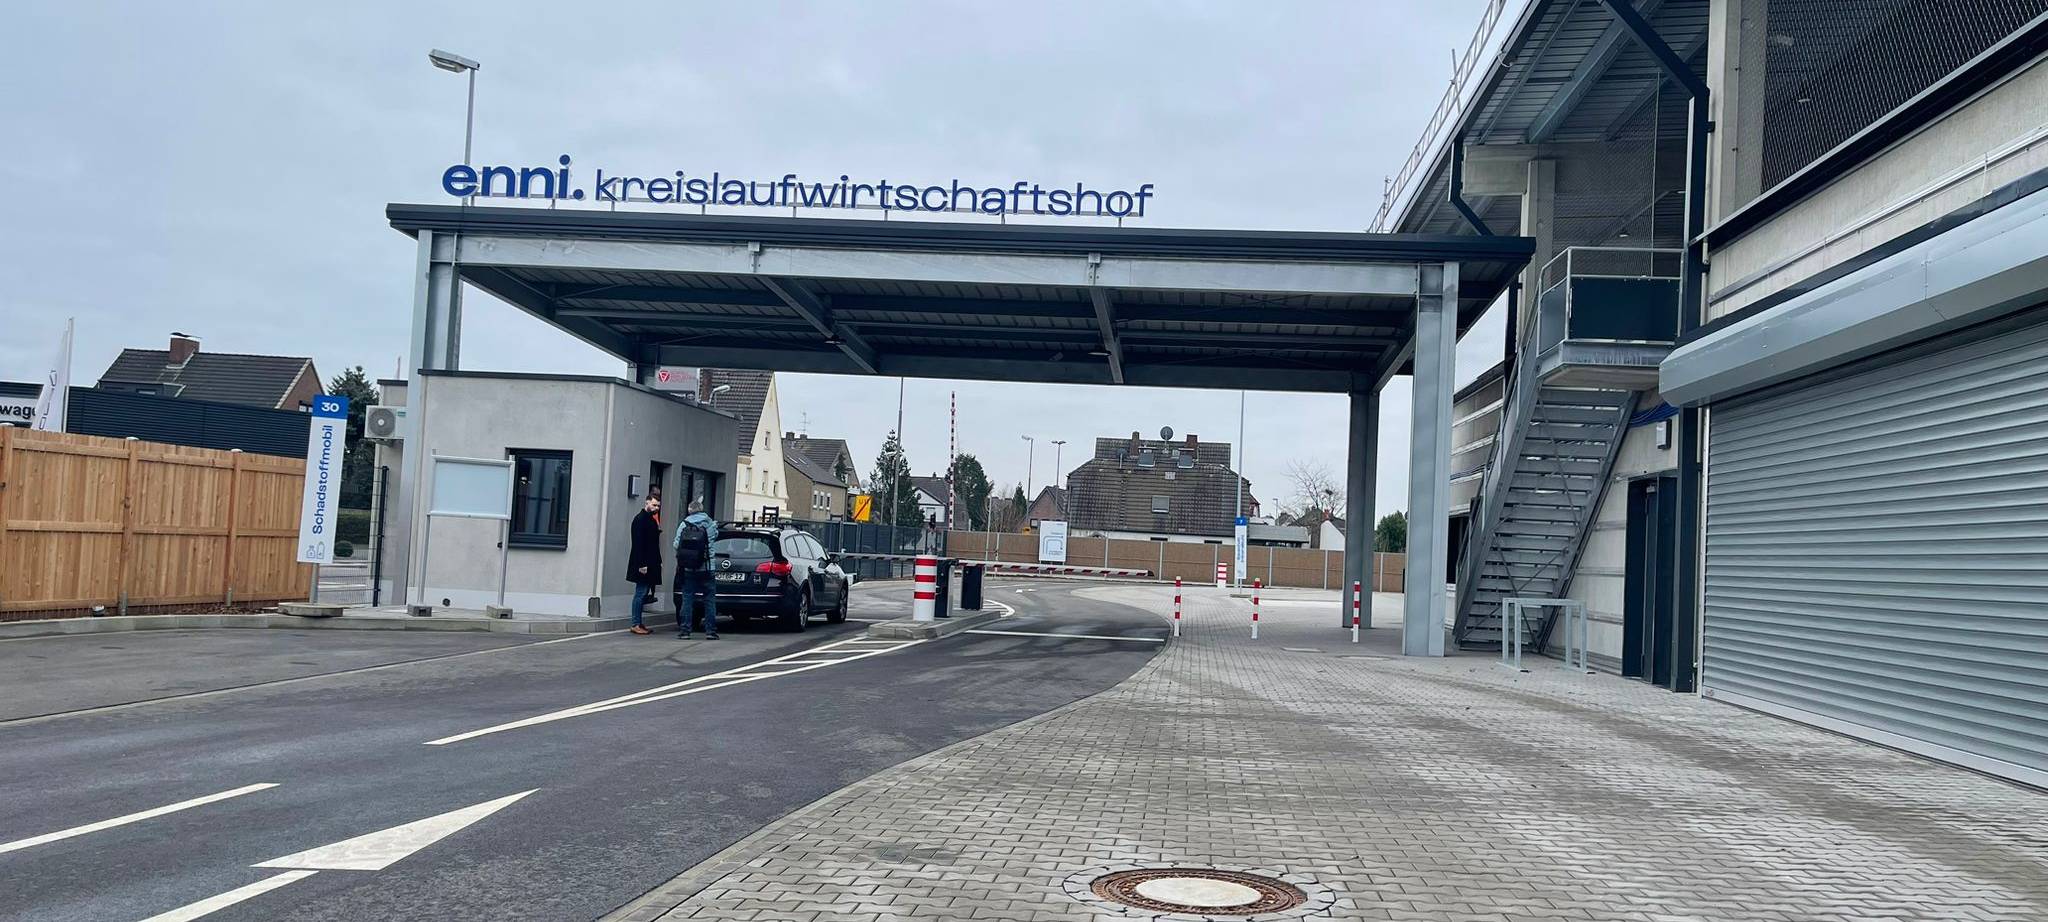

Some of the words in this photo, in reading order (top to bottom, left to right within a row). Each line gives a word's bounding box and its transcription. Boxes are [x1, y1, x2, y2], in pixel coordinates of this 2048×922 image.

[442, 154, 585, 200] enni.
[595, 170, 1153, 217] kreislaufwirtschaftshof
[321, 402, 340, 413] 30
[312, 425, 334, 535] Schadstoffmobil
